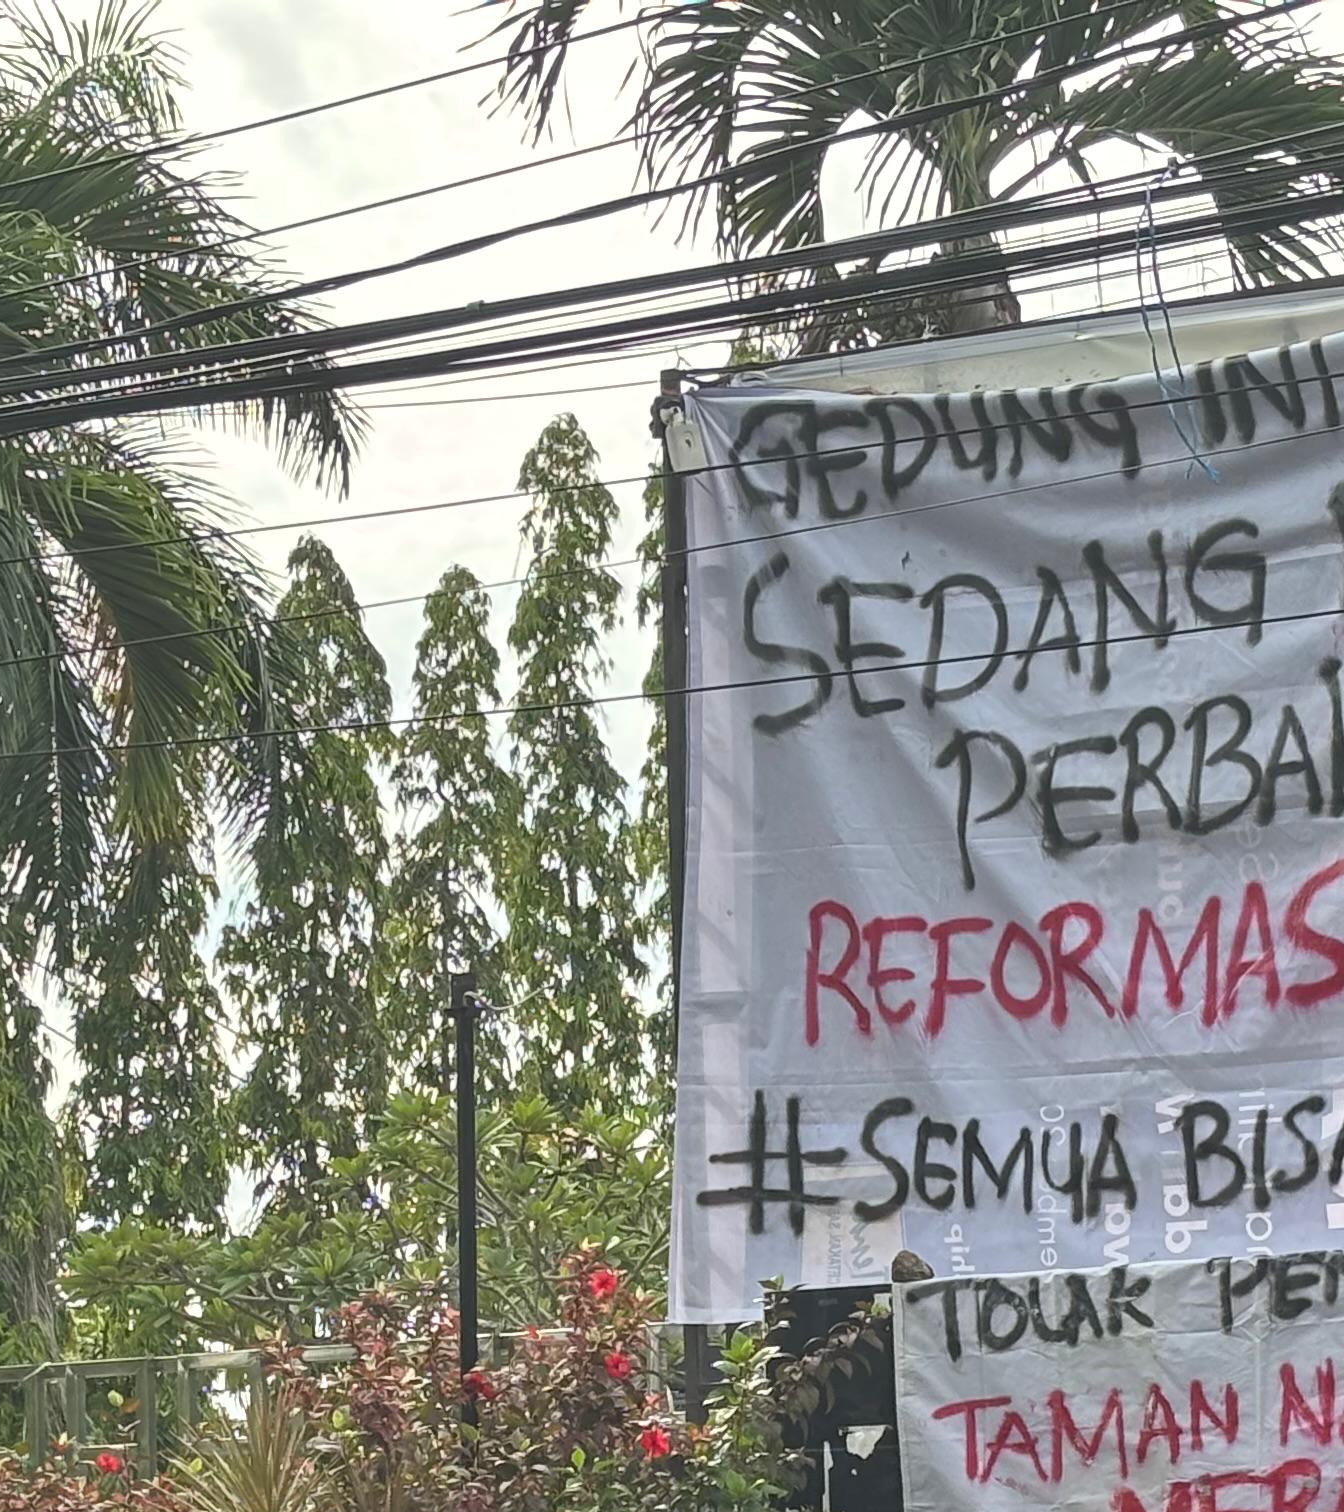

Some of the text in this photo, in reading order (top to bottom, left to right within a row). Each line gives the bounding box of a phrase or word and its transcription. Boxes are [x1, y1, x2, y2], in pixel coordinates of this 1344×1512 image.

[728, 378, 1142, 519] GEDUNG
[1194, 338, 1343, 445] INI
[744, 518, 1263, 735] SEDANG
[698, 1088, 1137, 1236] #SEMUA
[931, 1378, 1240, 1483] TAMAN
